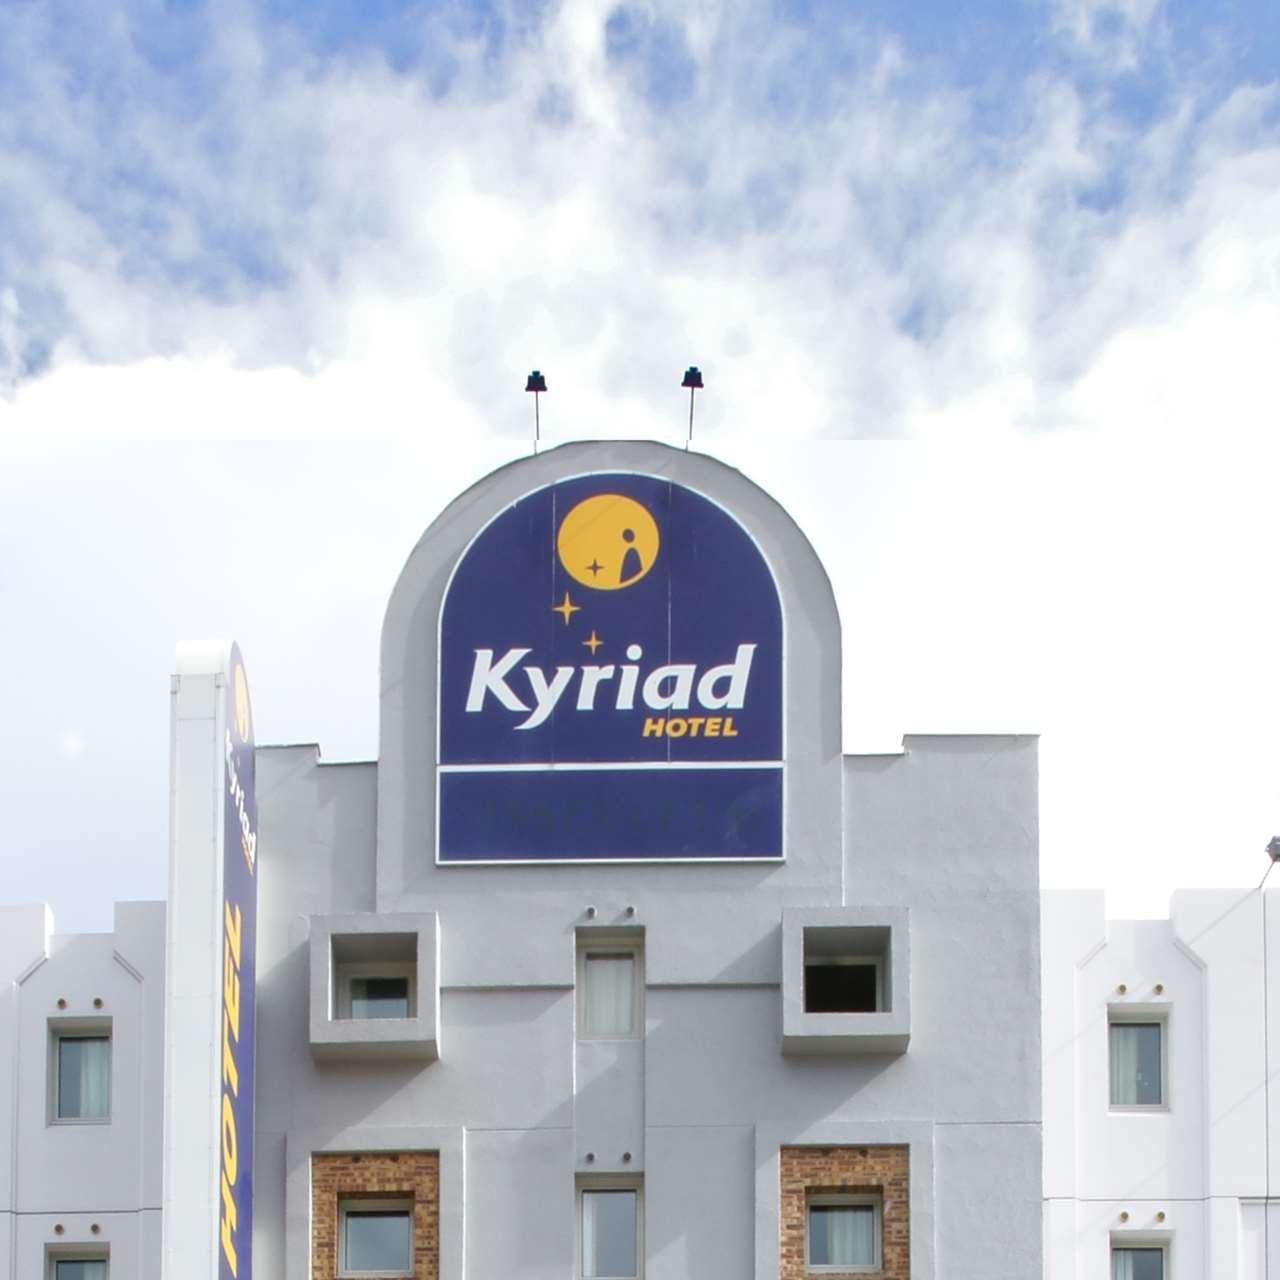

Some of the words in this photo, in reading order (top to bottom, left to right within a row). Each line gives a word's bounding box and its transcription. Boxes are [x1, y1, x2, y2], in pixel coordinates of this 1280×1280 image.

[466, 643, 757, 730] Kyriad
[643, 717, 738, 737] HOTEL
[221, 899, 242, 1279] HOTEL
